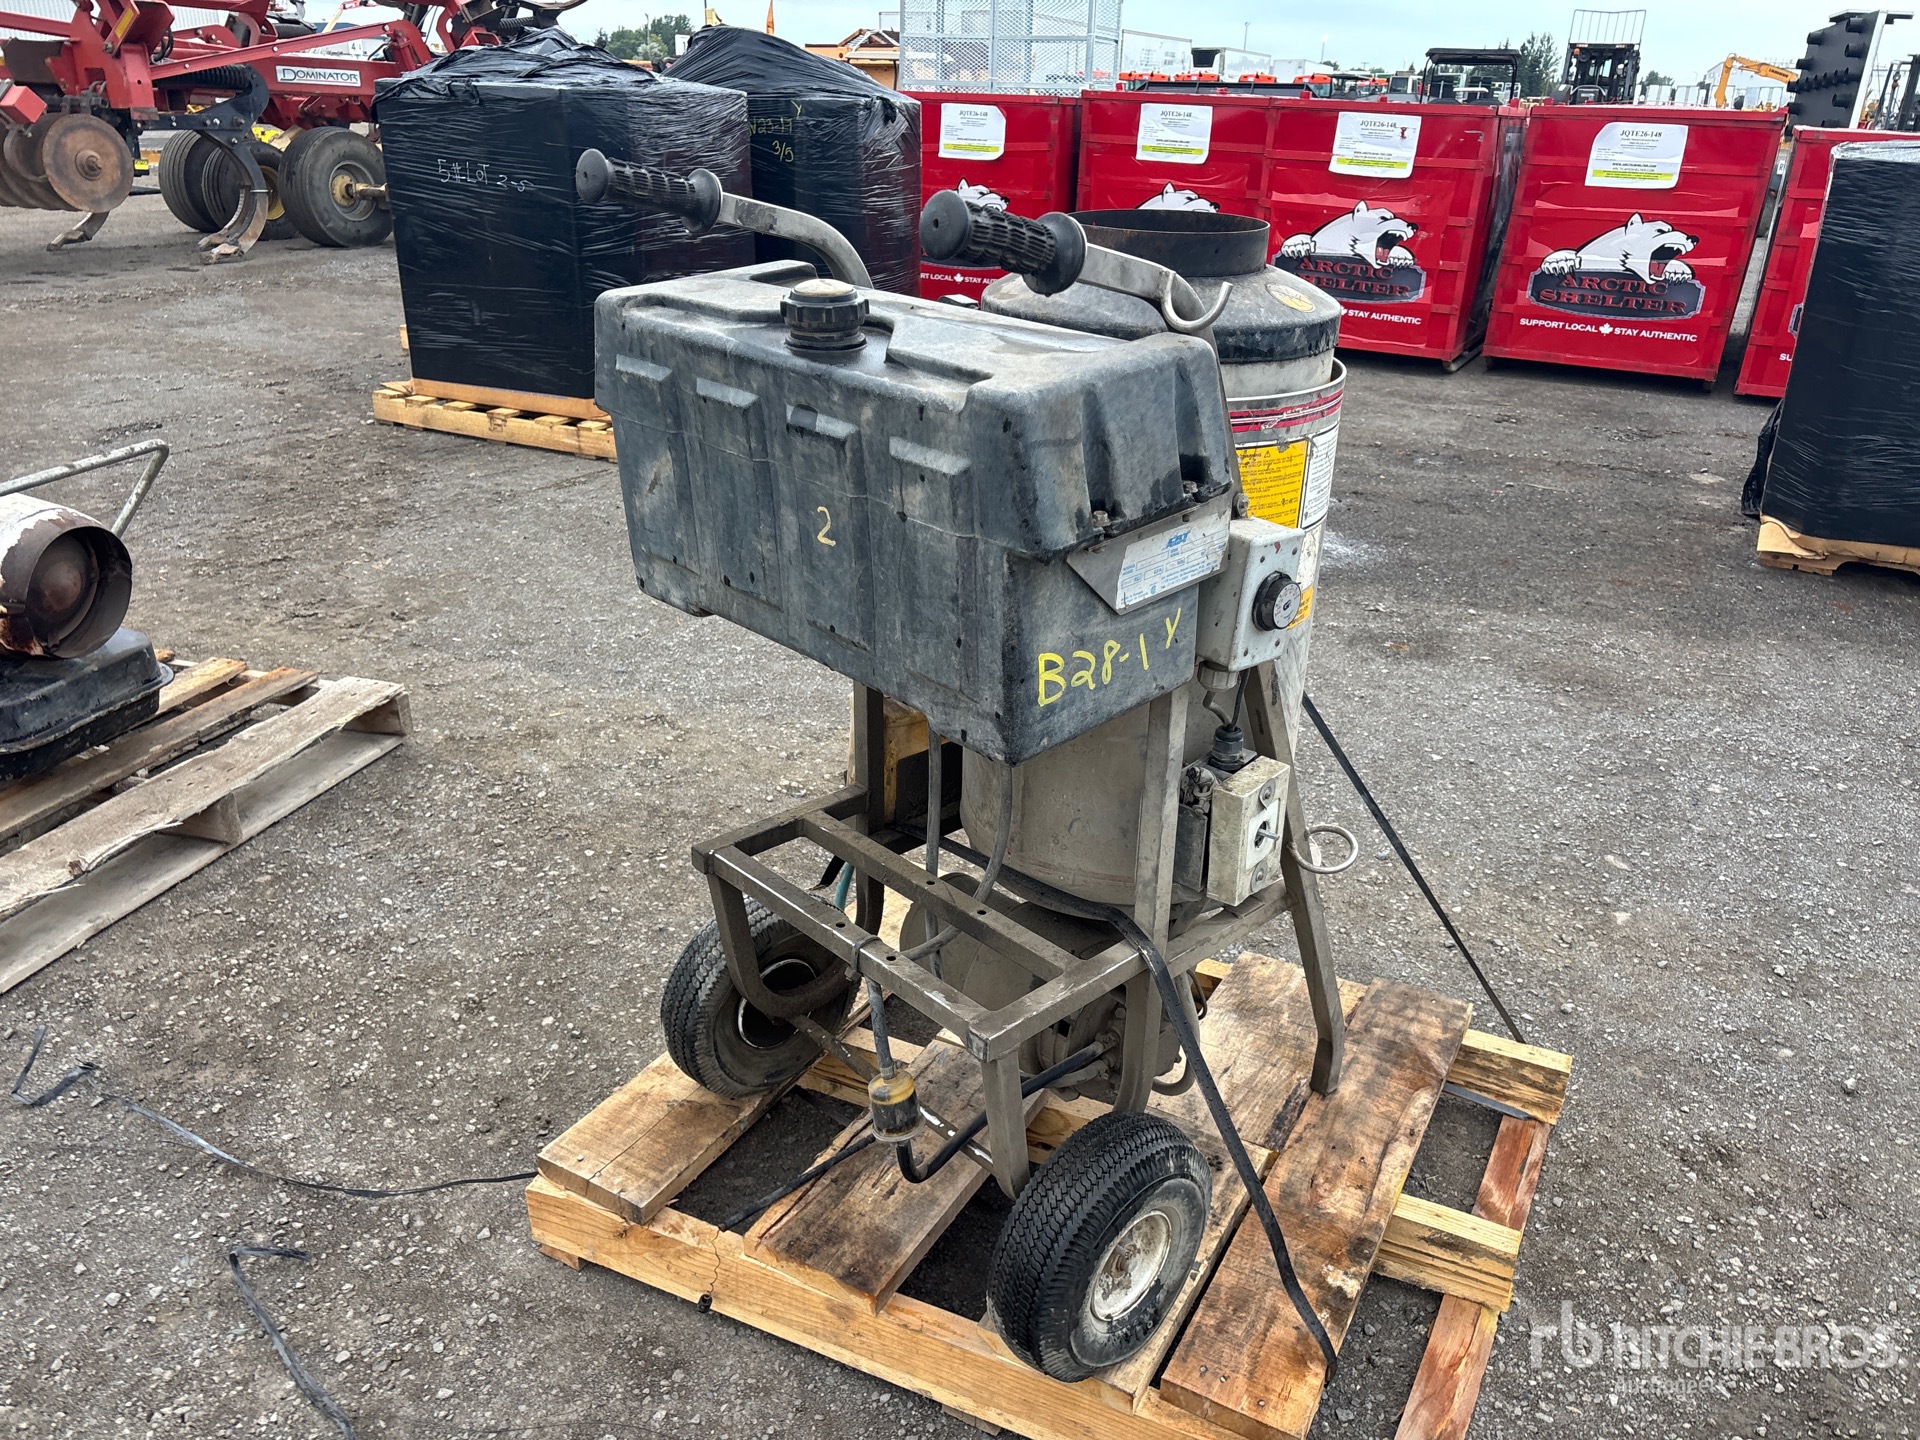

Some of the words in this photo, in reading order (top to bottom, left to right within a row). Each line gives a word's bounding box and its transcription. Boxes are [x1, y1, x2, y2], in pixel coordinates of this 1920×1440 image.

[280, 69, 358, 82] DOMINATOR
[772, 140, 794, 162] 3/5
[930, 273, 954, 282] LOCAL
[1297, 257, 1394, 280] ARCTIC
[1298, 272, 1410, 298] HELTER
[1559, 274, 1669, 296] ARCTIC
[1539, 289, 1688, 315] SHELTER
[1347, 309, 1370, 319] STAY
[1370, 312, 1422, 325] AUTHENTIC
[1519, 317, 1565, 329] SUPPORT
[1565, 322, 1598, 333] LOCAL
[1614, 327, 1639, 336] STAY
[1639, 329, 1698, 342] AUTHENTIC
[816, 505, 837, 547] 2
[1037, 632, 1150, 708] B28-1
